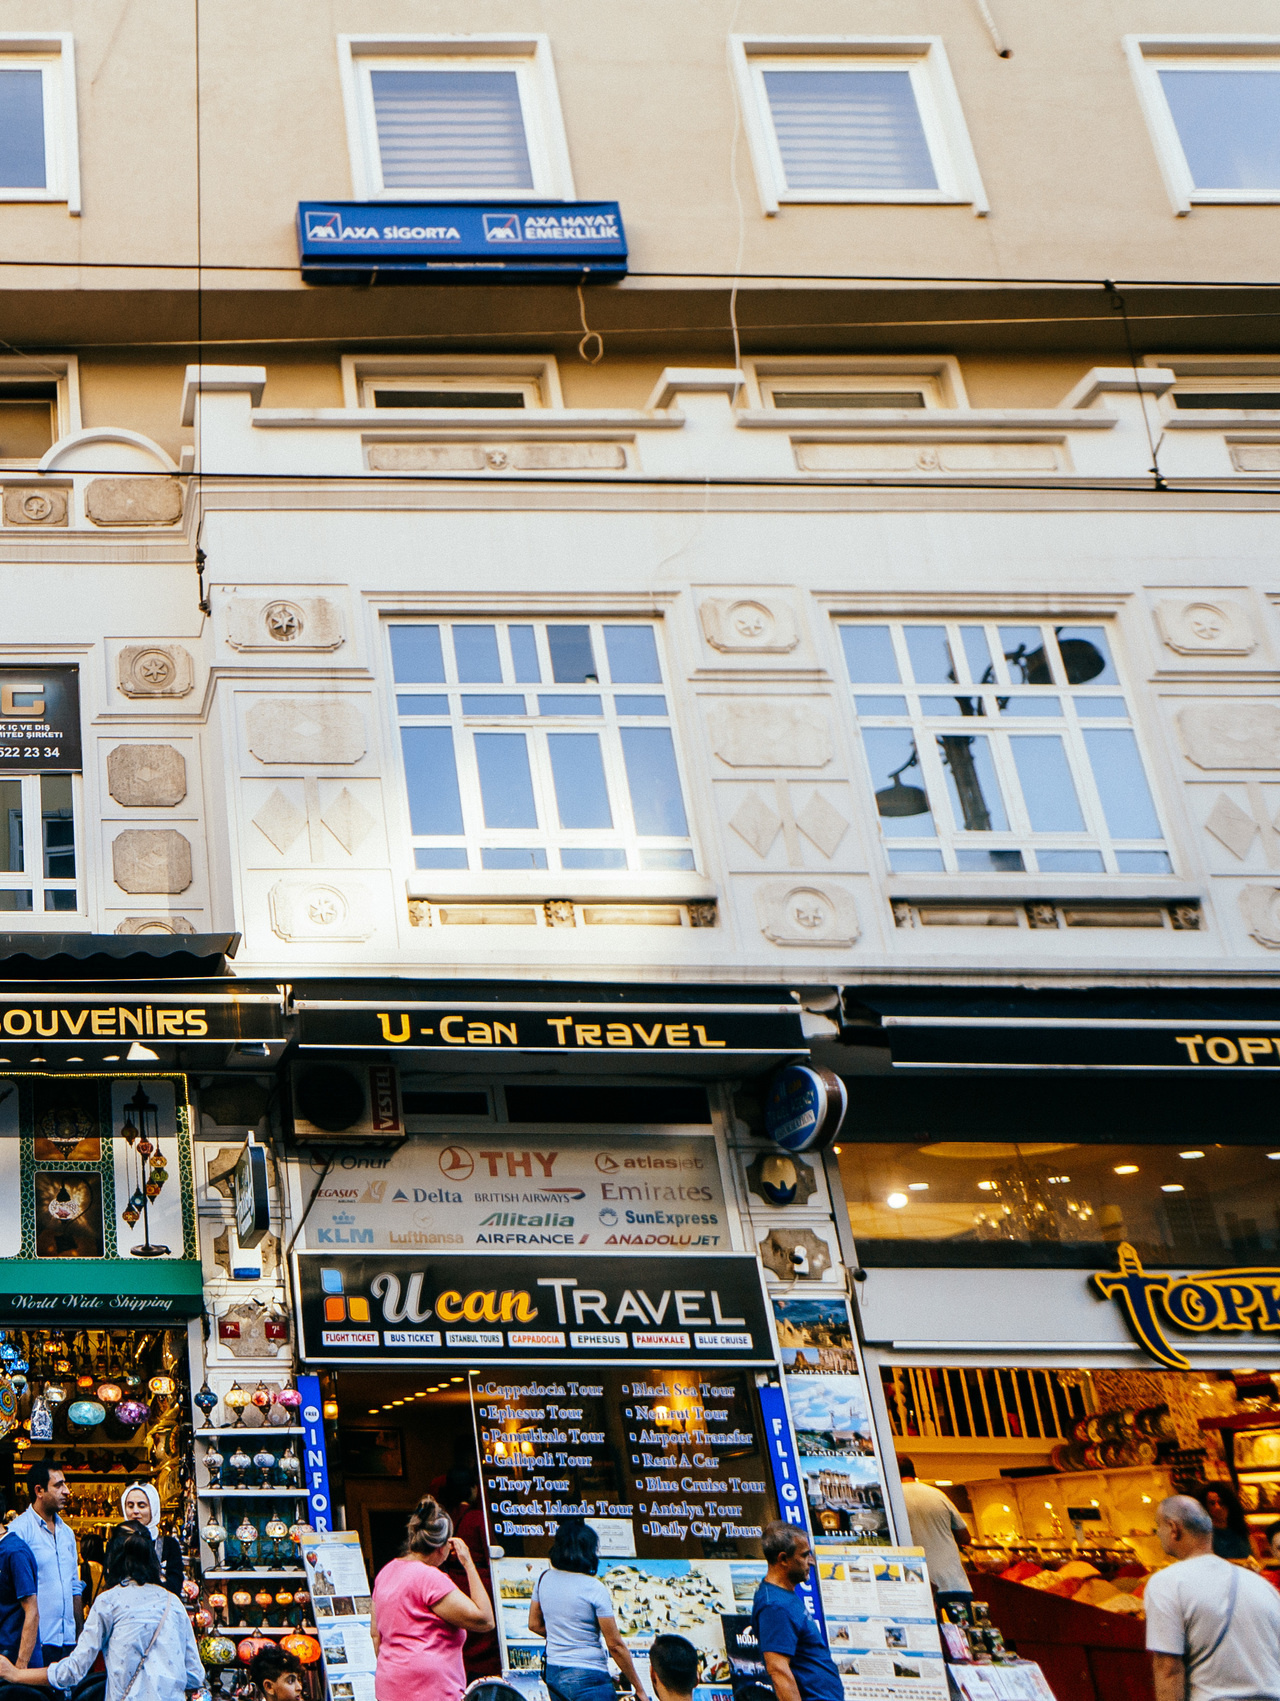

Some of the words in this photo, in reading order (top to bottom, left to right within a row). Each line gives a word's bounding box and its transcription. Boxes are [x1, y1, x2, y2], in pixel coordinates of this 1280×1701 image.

[524, 216, 559, 227] AXA
[561, 214, 616, 227] HAYAT
[341, 226, 380, 239] AXA
[23, 747, 40, 758] 23
[43, 747, 60, 758] 34
[1175, 1034, 1280, 1065] TOP
[341, 1155, 392, 1170] Onur
[480, 1152, 558, 1177] THY
[413, 1188, 463, 1204] Delta
[474, 1192, 520, 1203] BRITISH
[522, 1193, 570, 1204] AIRWAYS
[600, 1182, 713, 1201] Emirates
[478, 1212, 576, 1228] Alitalia
[625, 1209, 718, 1228] SunExpress
[318, 1228, 375, 1244] KLM
[389, 1230, 465, 1245] Lufthansa
[603, 1233, 721, 1246] ANADOLUJET
[11, 1294, 59, 1310] World
[62, 1294, 104, 1309] Wide
[109, 1294, 174, 1311] Shipping
[435, 1289, 538, 1323] can
[536, 1277, 746, 1326] TRAVEL
[325, 1333, 350, 1343] FLIGHT
[351, 1333, 375, 1343] TICKET
[390, 1334, 406, 1343] BUS
[408, 1334, 434, 1343] TICKET
[449, 1334, 479, 1343] ISTANBUL
[480, 1335, 500, 1343] TOURS
[512, 1335, 560, 1344] CAPPADOCIA
[577, 1335, 620, 1344] EPHESUS
[636, 1335, 686, 1344] PAMUKKALE
[698, 1336, 719, 1344] BLUE
[720, 1336, 748, 1345] CRUISE
[485, 1381, 566, 1400] Cappadocia
[567, 1382, 603, 1396] Tour
[632, 1382, 671, 1397] Black
[673, 1383, 697, 1397] Sea
[698, 1383, 735, 1397] Tour
[487, 1405, 545, 1423] Ephesus
[546, 1405, 583, 1419] Tour
[692, 1406, 728, 1420] Tour
[490, 1428, 567, 1443] Pamukkale
[568, 1429, 605, 1443] Tour
[639, 1429, 691, 1448] Airport
[692, 1429, 753, 1444] Transfer
[494, 1452, 555, 1470] Gallipoli
[555, 1453, 592, 1467] Tour
[642, 1453, 677, 1468] Rent
[679, 1454, 692, 1468] A
[693, 1454, 719, 1468] Car
[772, 1419, 801, 1525] FLIGH
[308, 1429, 329, 1533] INFOR
[496, 1476, 532, 1495] Troy
[532, 1476, 569, 1491] Tour
[645, 1477, 679, 1492] Blue
[681, 1477, 728, 1492] Cruise
[728, 1478, 765, 1492] Tour
[500, 1500, 543, 1515] Greek
[544, 1500, 595, 1515] Islands
[596, 1501, 633, 1516] Tour
[650, 1501, 704, 1520] Antalya
[705, 1502, 742, 1516] Tour
[502, 1520, 544, 1535] Bursa
[650, 1521, 688, 1541] Daily
[691, 1522, 721, 1541] City
[722, 1523, 763, 1538] Tours
